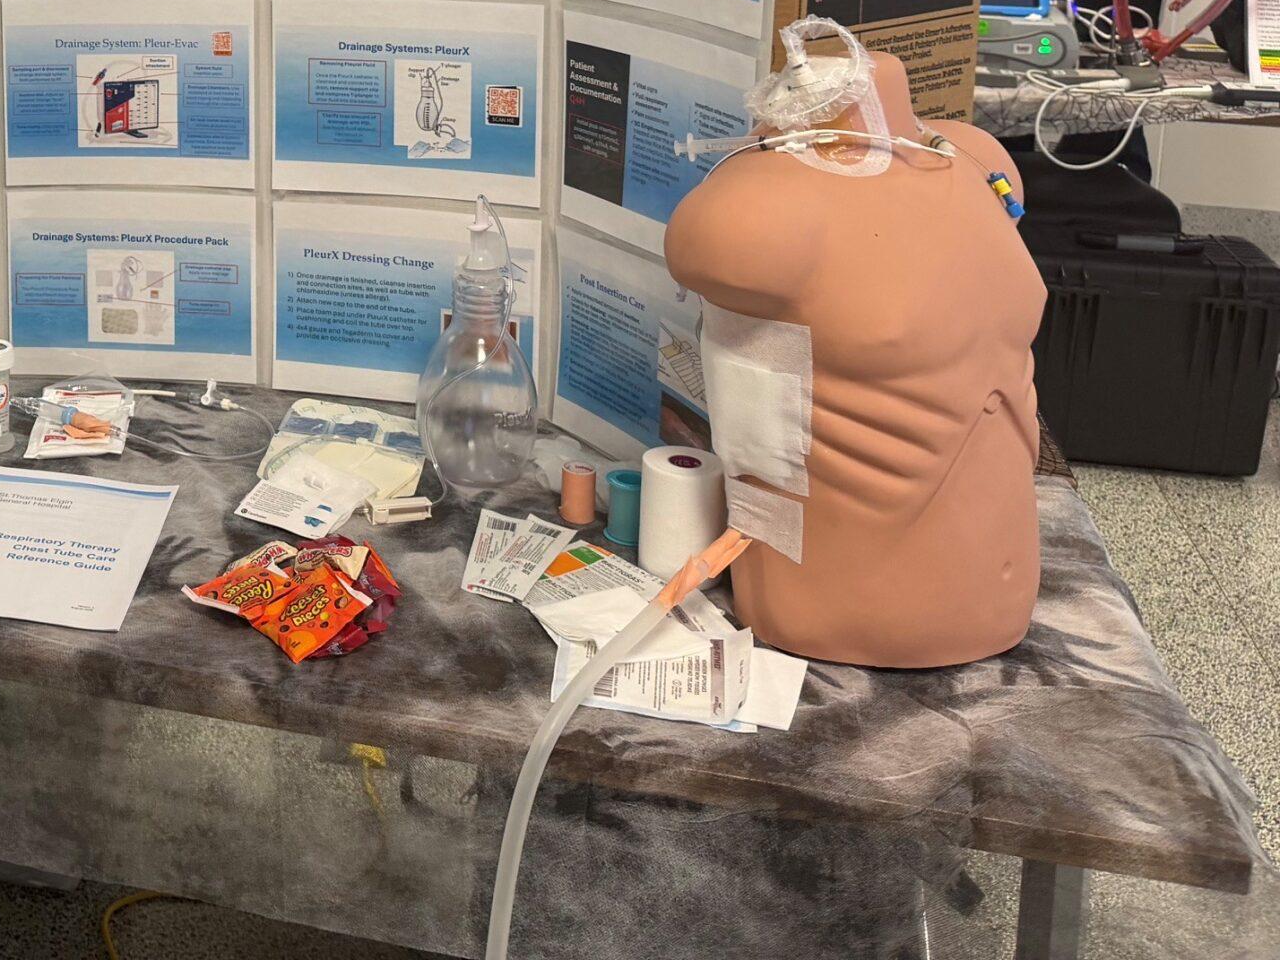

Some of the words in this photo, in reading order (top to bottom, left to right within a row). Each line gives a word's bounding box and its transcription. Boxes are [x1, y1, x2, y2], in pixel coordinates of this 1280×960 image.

[55, 38, 100, 51] Drainage
[102, 38, 141, 50] System:
[144, 38, 199, 49] Pleur-Evac
[338, 41, 383, 53] Drainage
[385, 43, 433, 55] Systems:
[435, 46, 470, 56] PleurX
[570, 59, 595, 73] Patient
[570, 72, 612, 89] Assessment
[613, 81, 618, 91] &
[570, 83, 621, 105] Documentation
[32, 233, 74, 243] Drainage
[75, 233, 119, 243] Systems:
[121, 234, 153, 243] PleurX
[155, 235, 203, 245] Procedure
[205, 237, 229, 246] Pack
[303, 249, 339, 260] PleurX
[342, 252, 390, 267] Dressing
[393, 256, 434, 270] Change
[315, 274, 342, 282] drainage
[350, 277, 378, 285] finished,
[380, 280, 405, 288] cleanse
[407, 282, 436, 291] insertion
[580, 274, 595, 288] Post
[596, 280, 628, 303] Insertion
[629, 296, 646, 311] Care
[12, 493, 48, 502] Thomas
[50, 497, 73, 505] Elgin
[33, 500, 71, 510] Hospital
[13, 543, 50, 555] Chest
[53, 547, 84, 558] Tube
[86, 551, 116, 563] Care
[70, 540, 120, 555] Therapy
[6, 552, 70, 567] Reference
[73, 559, 112, 572] Guide
